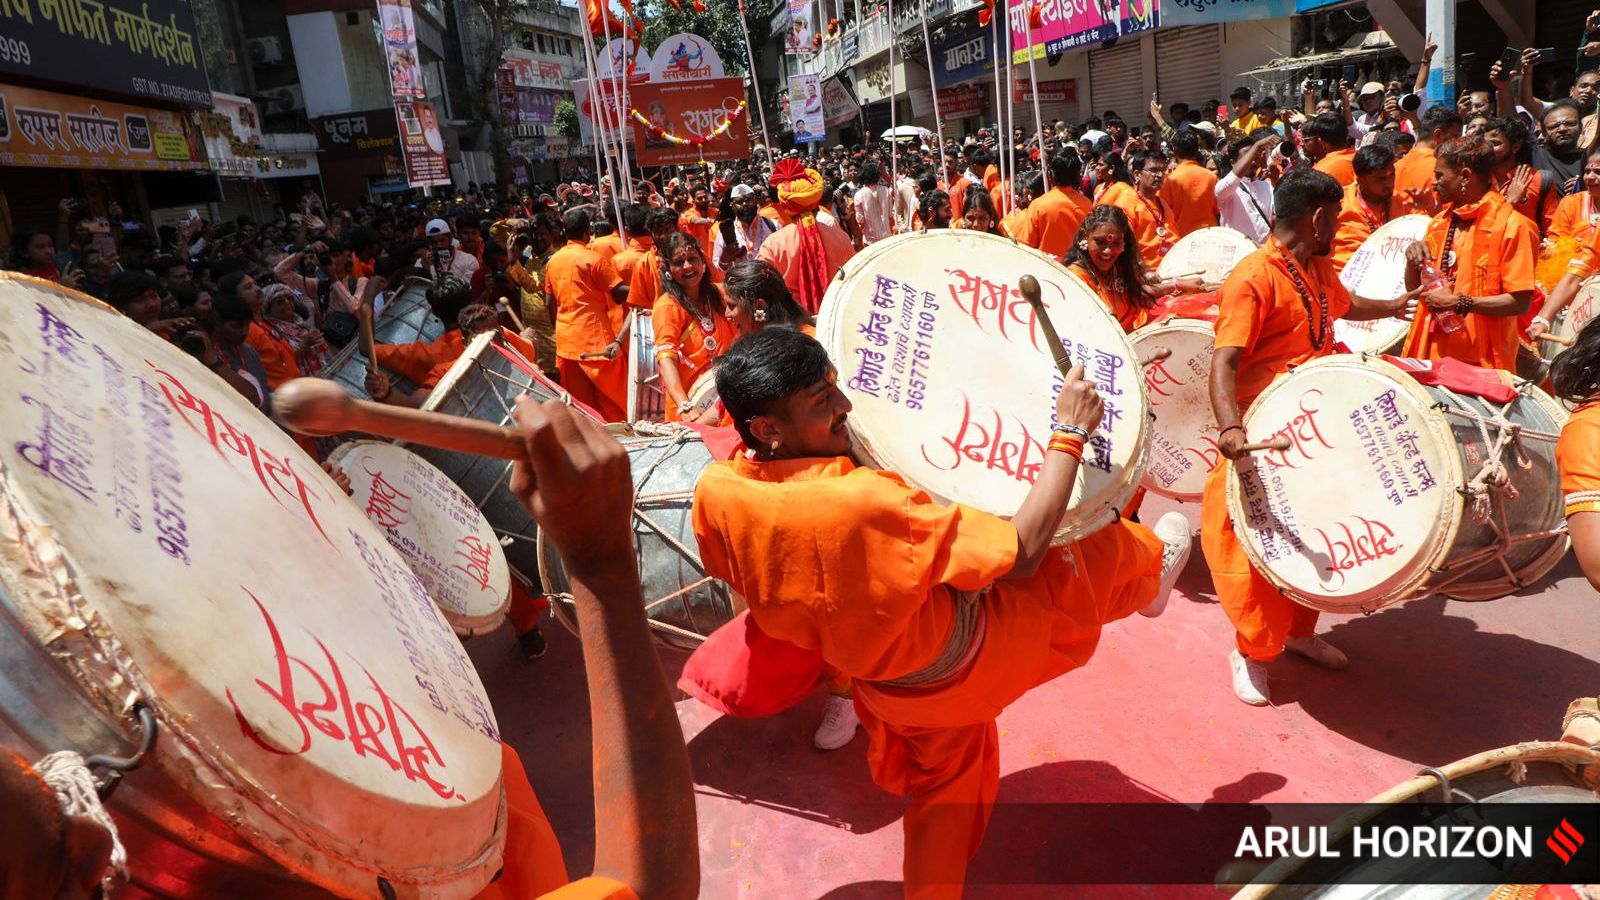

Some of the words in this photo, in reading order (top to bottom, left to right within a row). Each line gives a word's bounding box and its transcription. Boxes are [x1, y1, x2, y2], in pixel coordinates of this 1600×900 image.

[110, 3, 197, 68] मार्गदर्शन
[944, 36, 987, 71] मानस
[132, 77, 147, 93] GST
[324, 116, 369, 143] पूनम
[871, 274, 899, 309] सन्स
[905, 311, 936, 410] 9657761160
[921, 290, 940, 311] पुणे
[884, 376, 901, 403] ढोल
[1362, 403, 1378, 423] ढोल
[1349, 409, 1394, 489] 9657761160
[1410, 459, 1437, 492] सन्स
[1271, 474, 1306, 553] 9657761160
[1313, 515, 1404, 592] समर्थ
[226, 584, 467, 803] समर्थ
